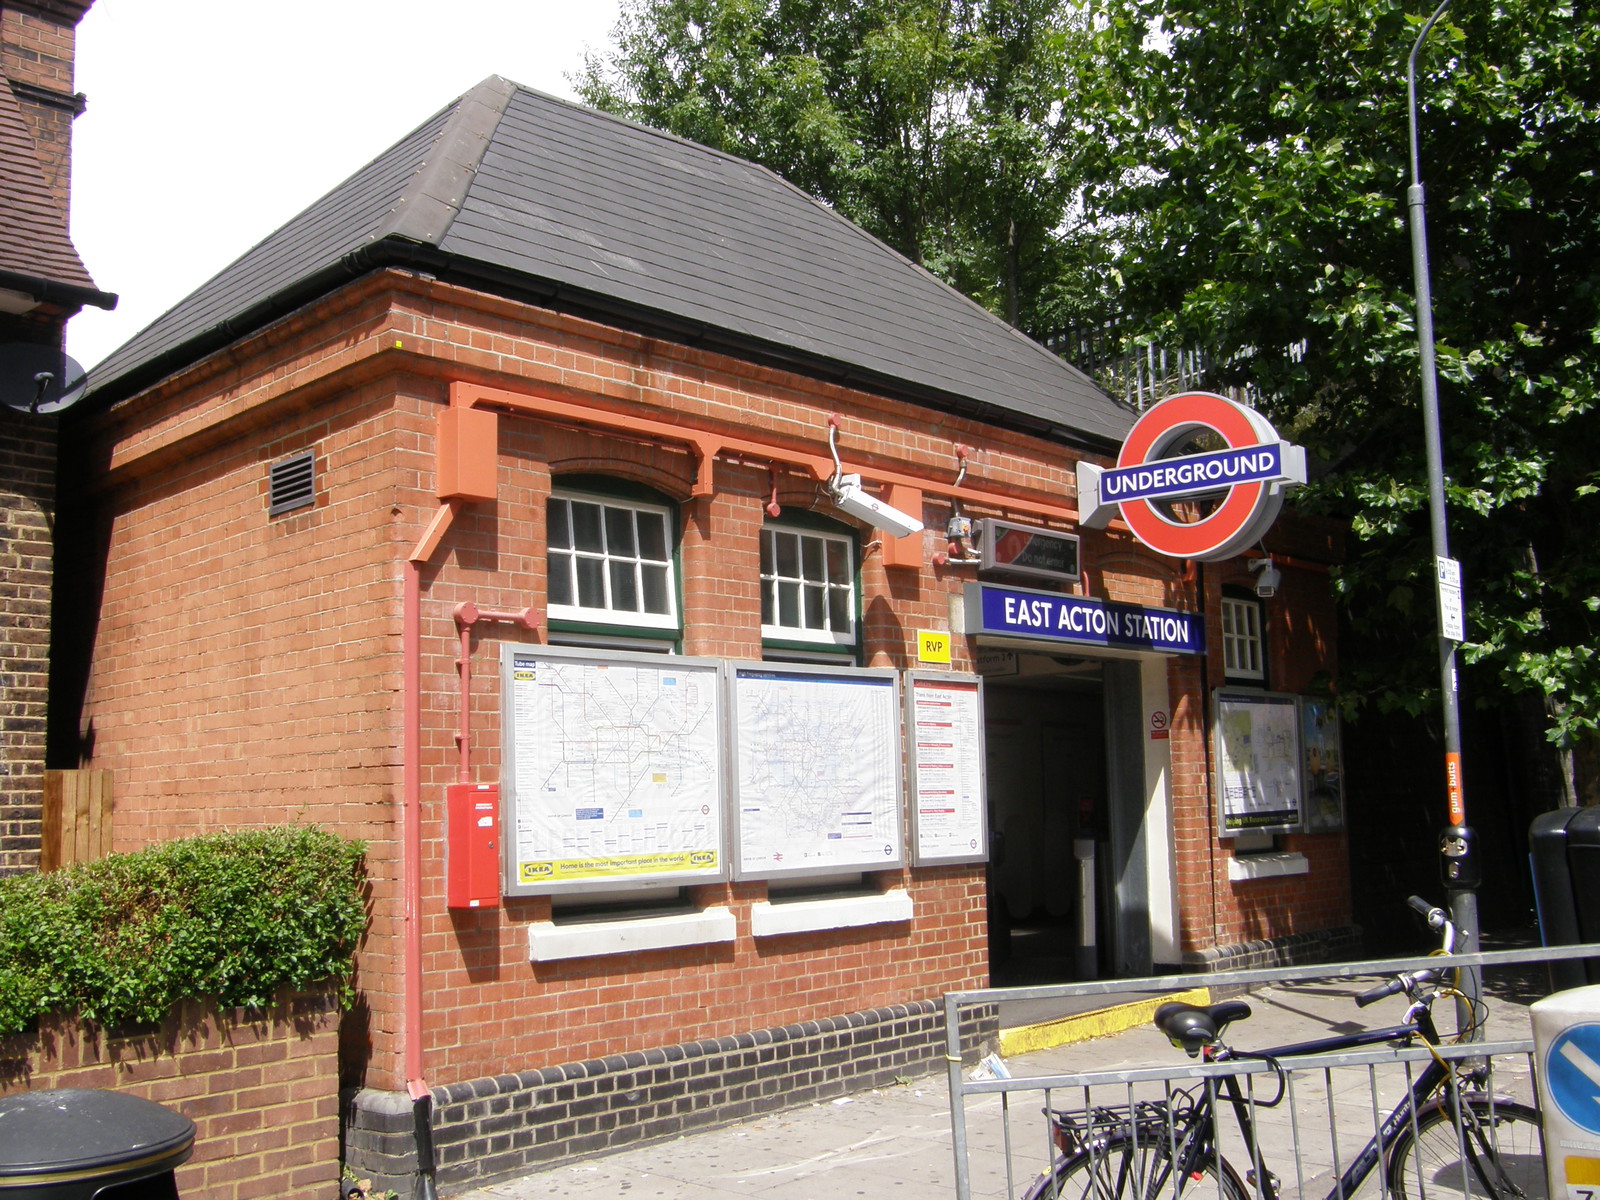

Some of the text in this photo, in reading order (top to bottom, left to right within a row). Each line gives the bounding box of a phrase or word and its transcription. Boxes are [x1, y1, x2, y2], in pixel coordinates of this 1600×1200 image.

[1106, 452, 1275, 495] UNDERGROUND
[1004, 597, 1189, 643] EAST ACTON STATION
[926, 640, 943, 652] RVP
[610, 859, 637, 868] important
